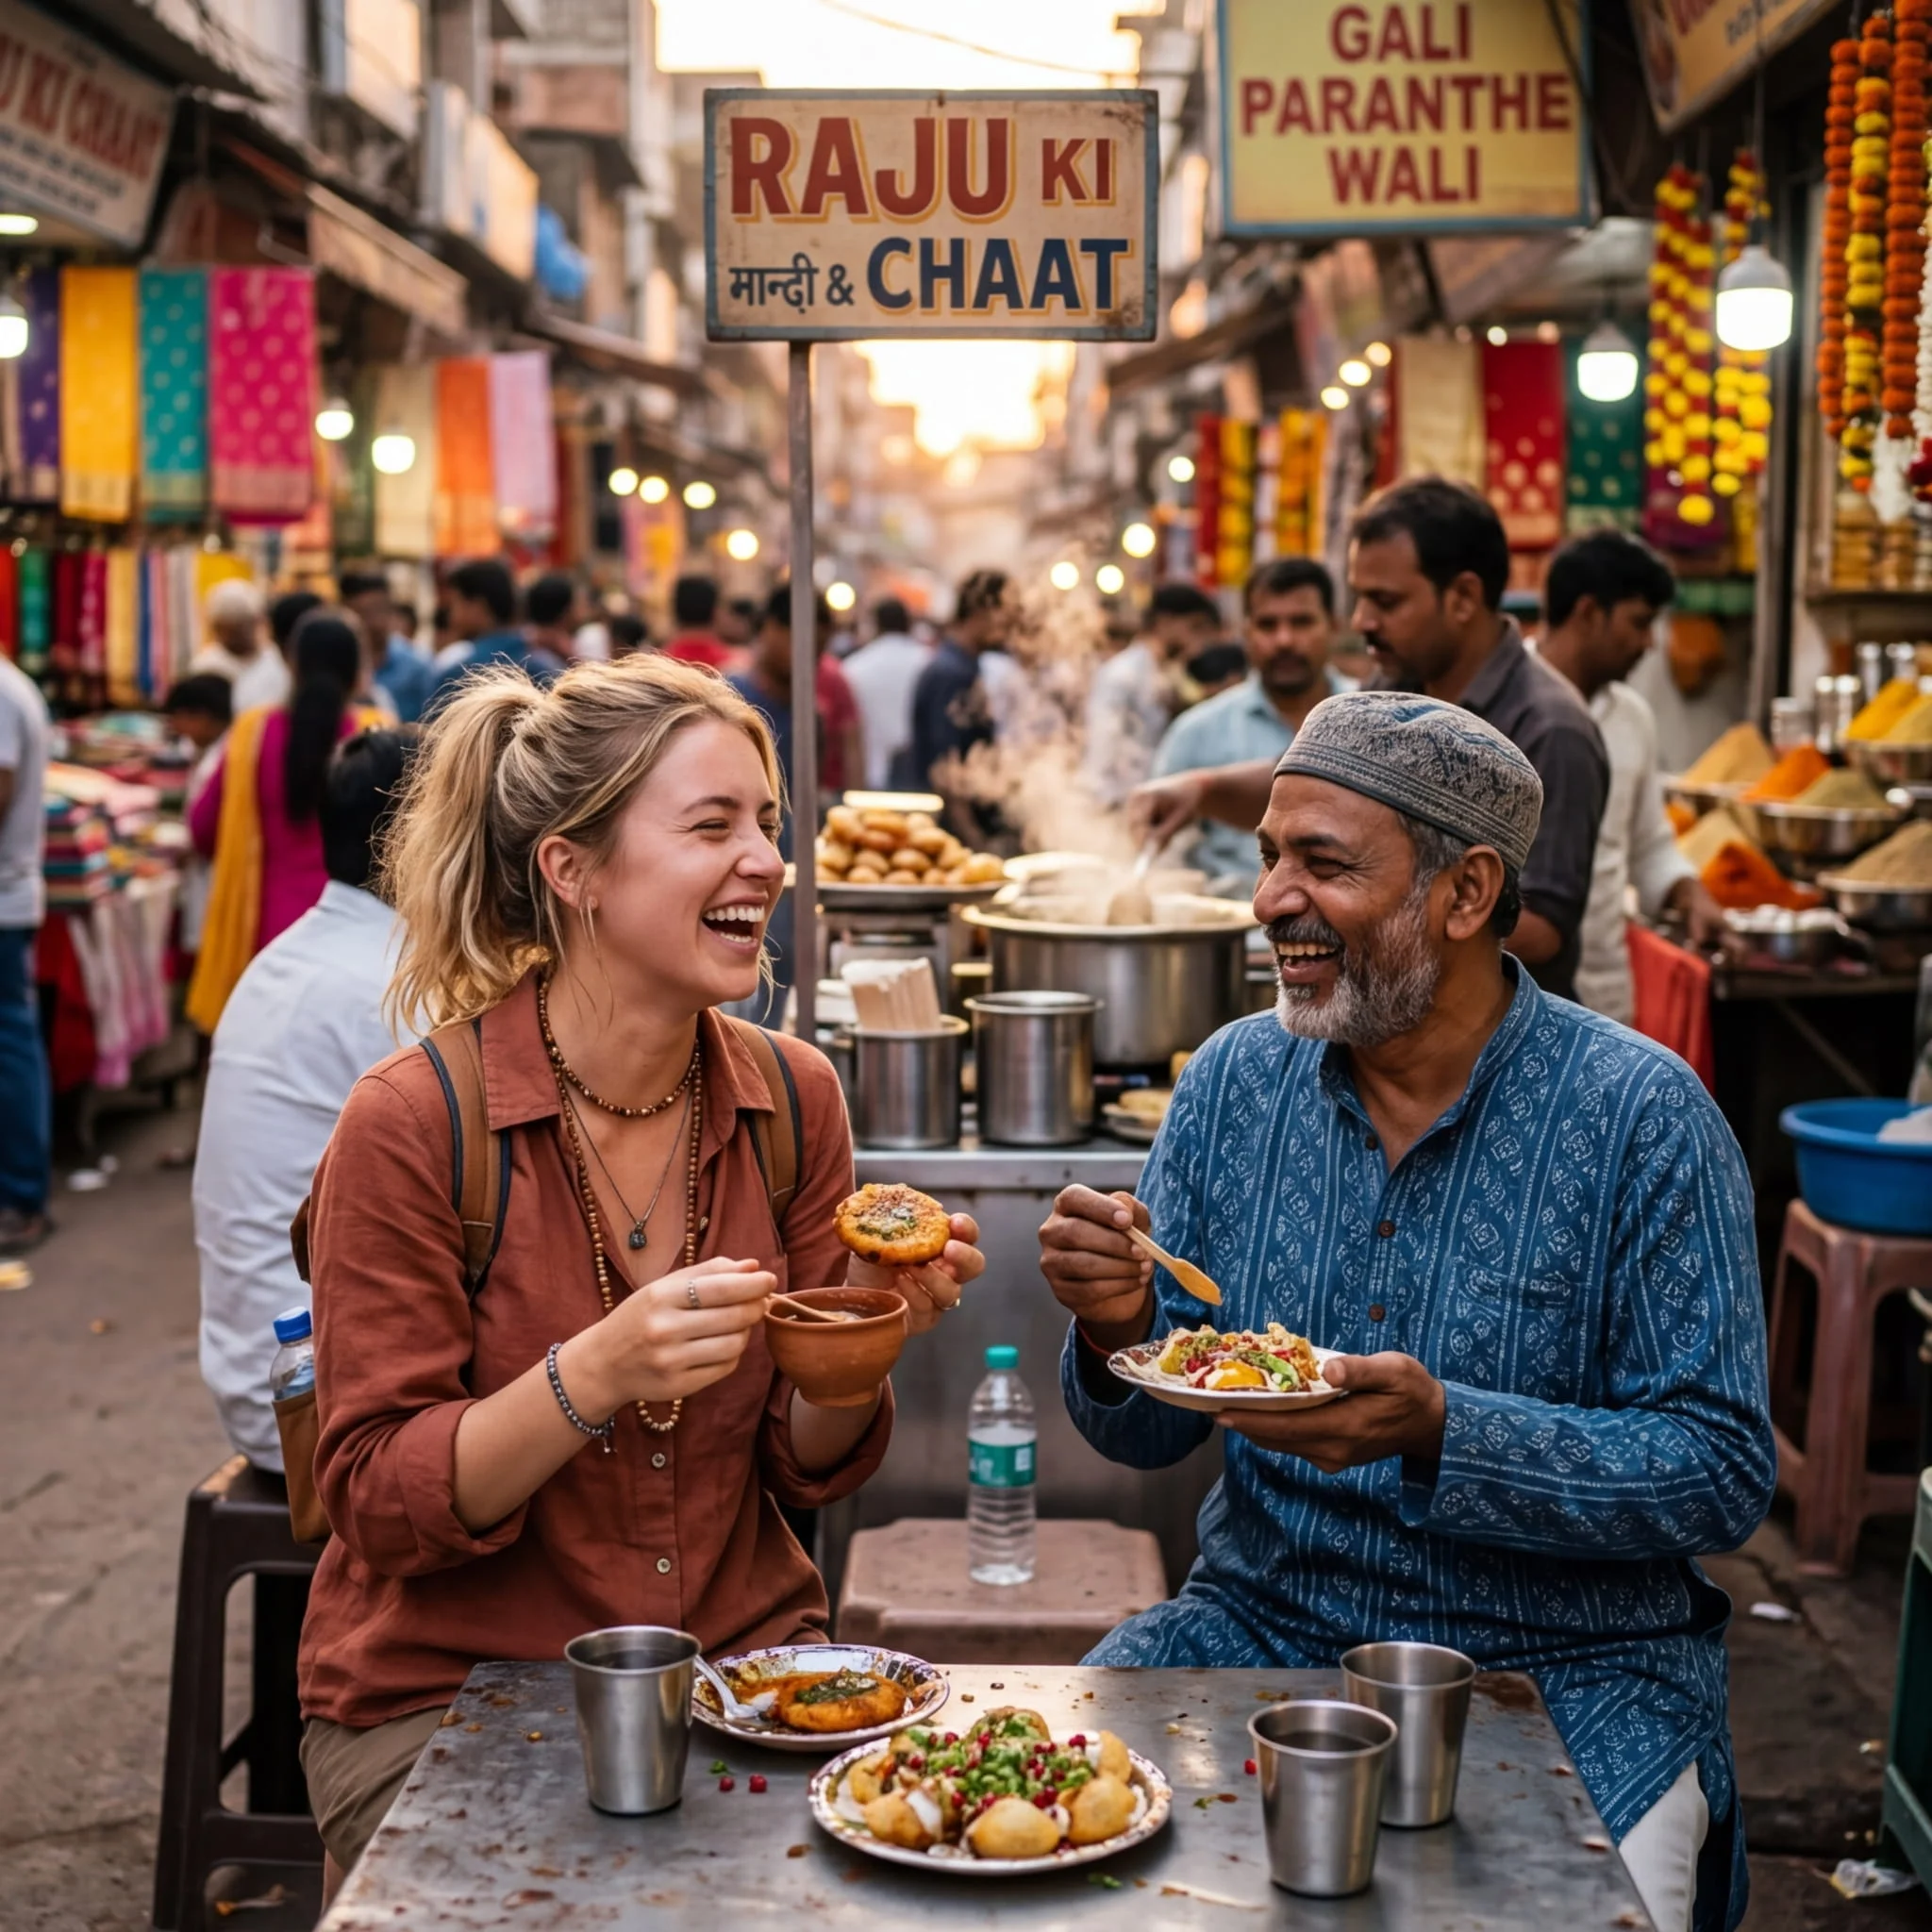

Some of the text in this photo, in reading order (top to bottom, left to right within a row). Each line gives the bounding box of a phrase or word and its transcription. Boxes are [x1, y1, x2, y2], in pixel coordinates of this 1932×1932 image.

[1330, 5, 1471, 63] GALI
[1241, 72, 1573, 137] PARANTHE
[730, 117, 1112, 218] RAJU KI
[1328, 144, 1481, 205] WALI
[826, 263, 855, 306] &
[867, 237, 1131, 311] CHAAT
